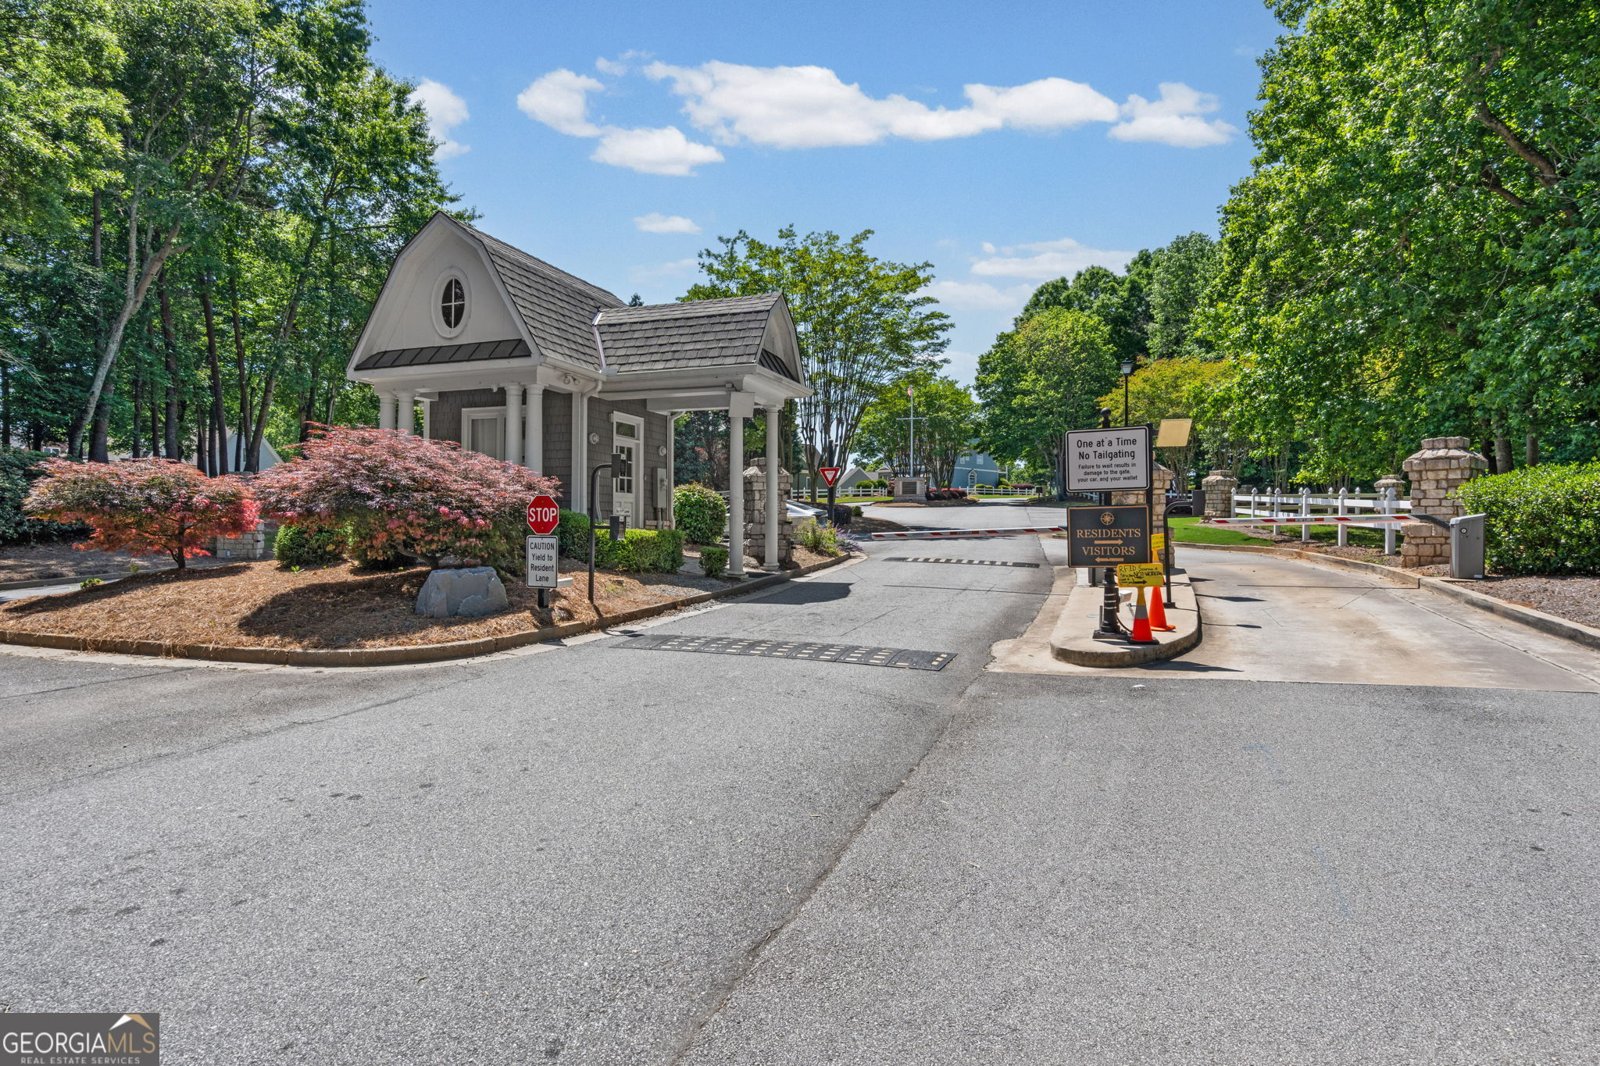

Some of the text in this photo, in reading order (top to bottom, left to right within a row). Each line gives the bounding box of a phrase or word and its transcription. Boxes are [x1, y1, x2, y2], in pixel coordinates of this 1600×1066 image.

[1076, 440, 1093, 448] One
[1096, 438, 1104, 447] at
[1116, 437, 1137, 446] Time
[1078, 450, 1135, 461] No Tailgating
[529, 508, 556, 522] STOP
[1076, 528, 1141, 538] RESIDENTS
[1082, 546, 1136, 556] VISITORS
[531, 564, 554, 572] Resident
